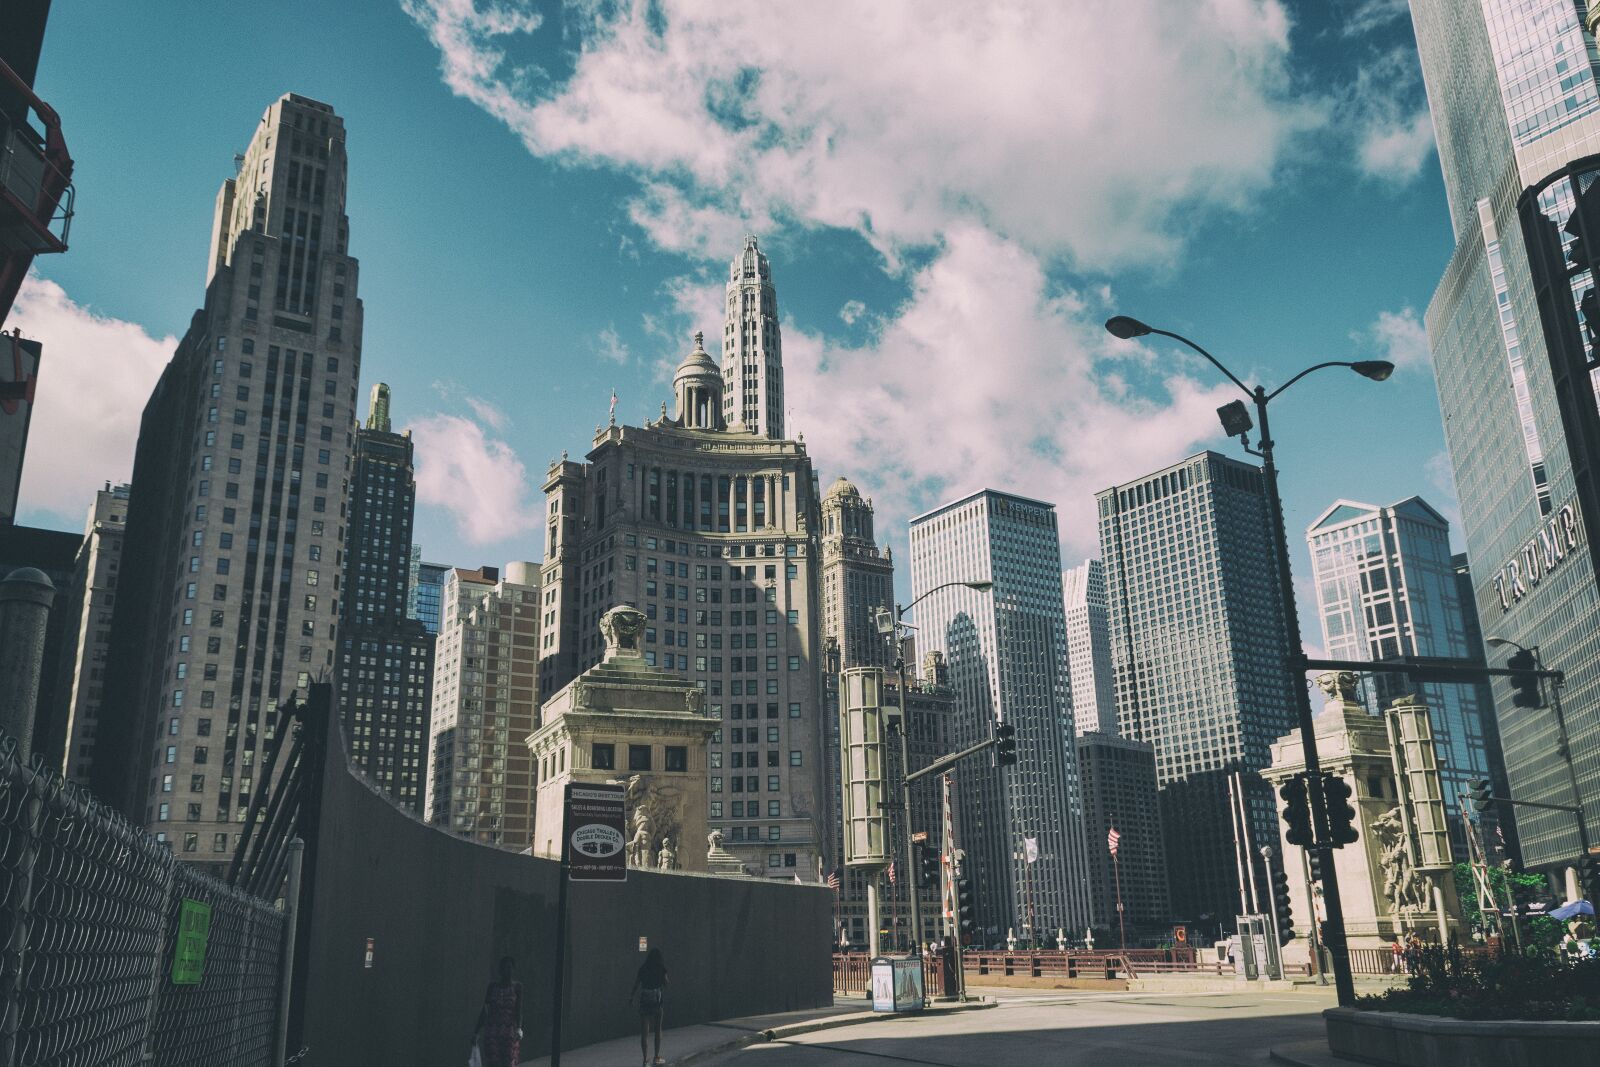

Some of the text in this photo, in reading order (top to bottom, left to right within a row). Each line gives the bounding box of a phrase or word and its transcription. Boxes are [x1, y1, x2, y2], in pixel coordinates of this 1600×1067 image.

[1009, 503, 1047, 517] KEMPER
[1493, 504, 1576, 613] TRUMP
[576, 828, 595, 836] CHICAGO
[596, 828, 615, 836] TROLLEY
[576, 834, 593, 842] DOUBLE
